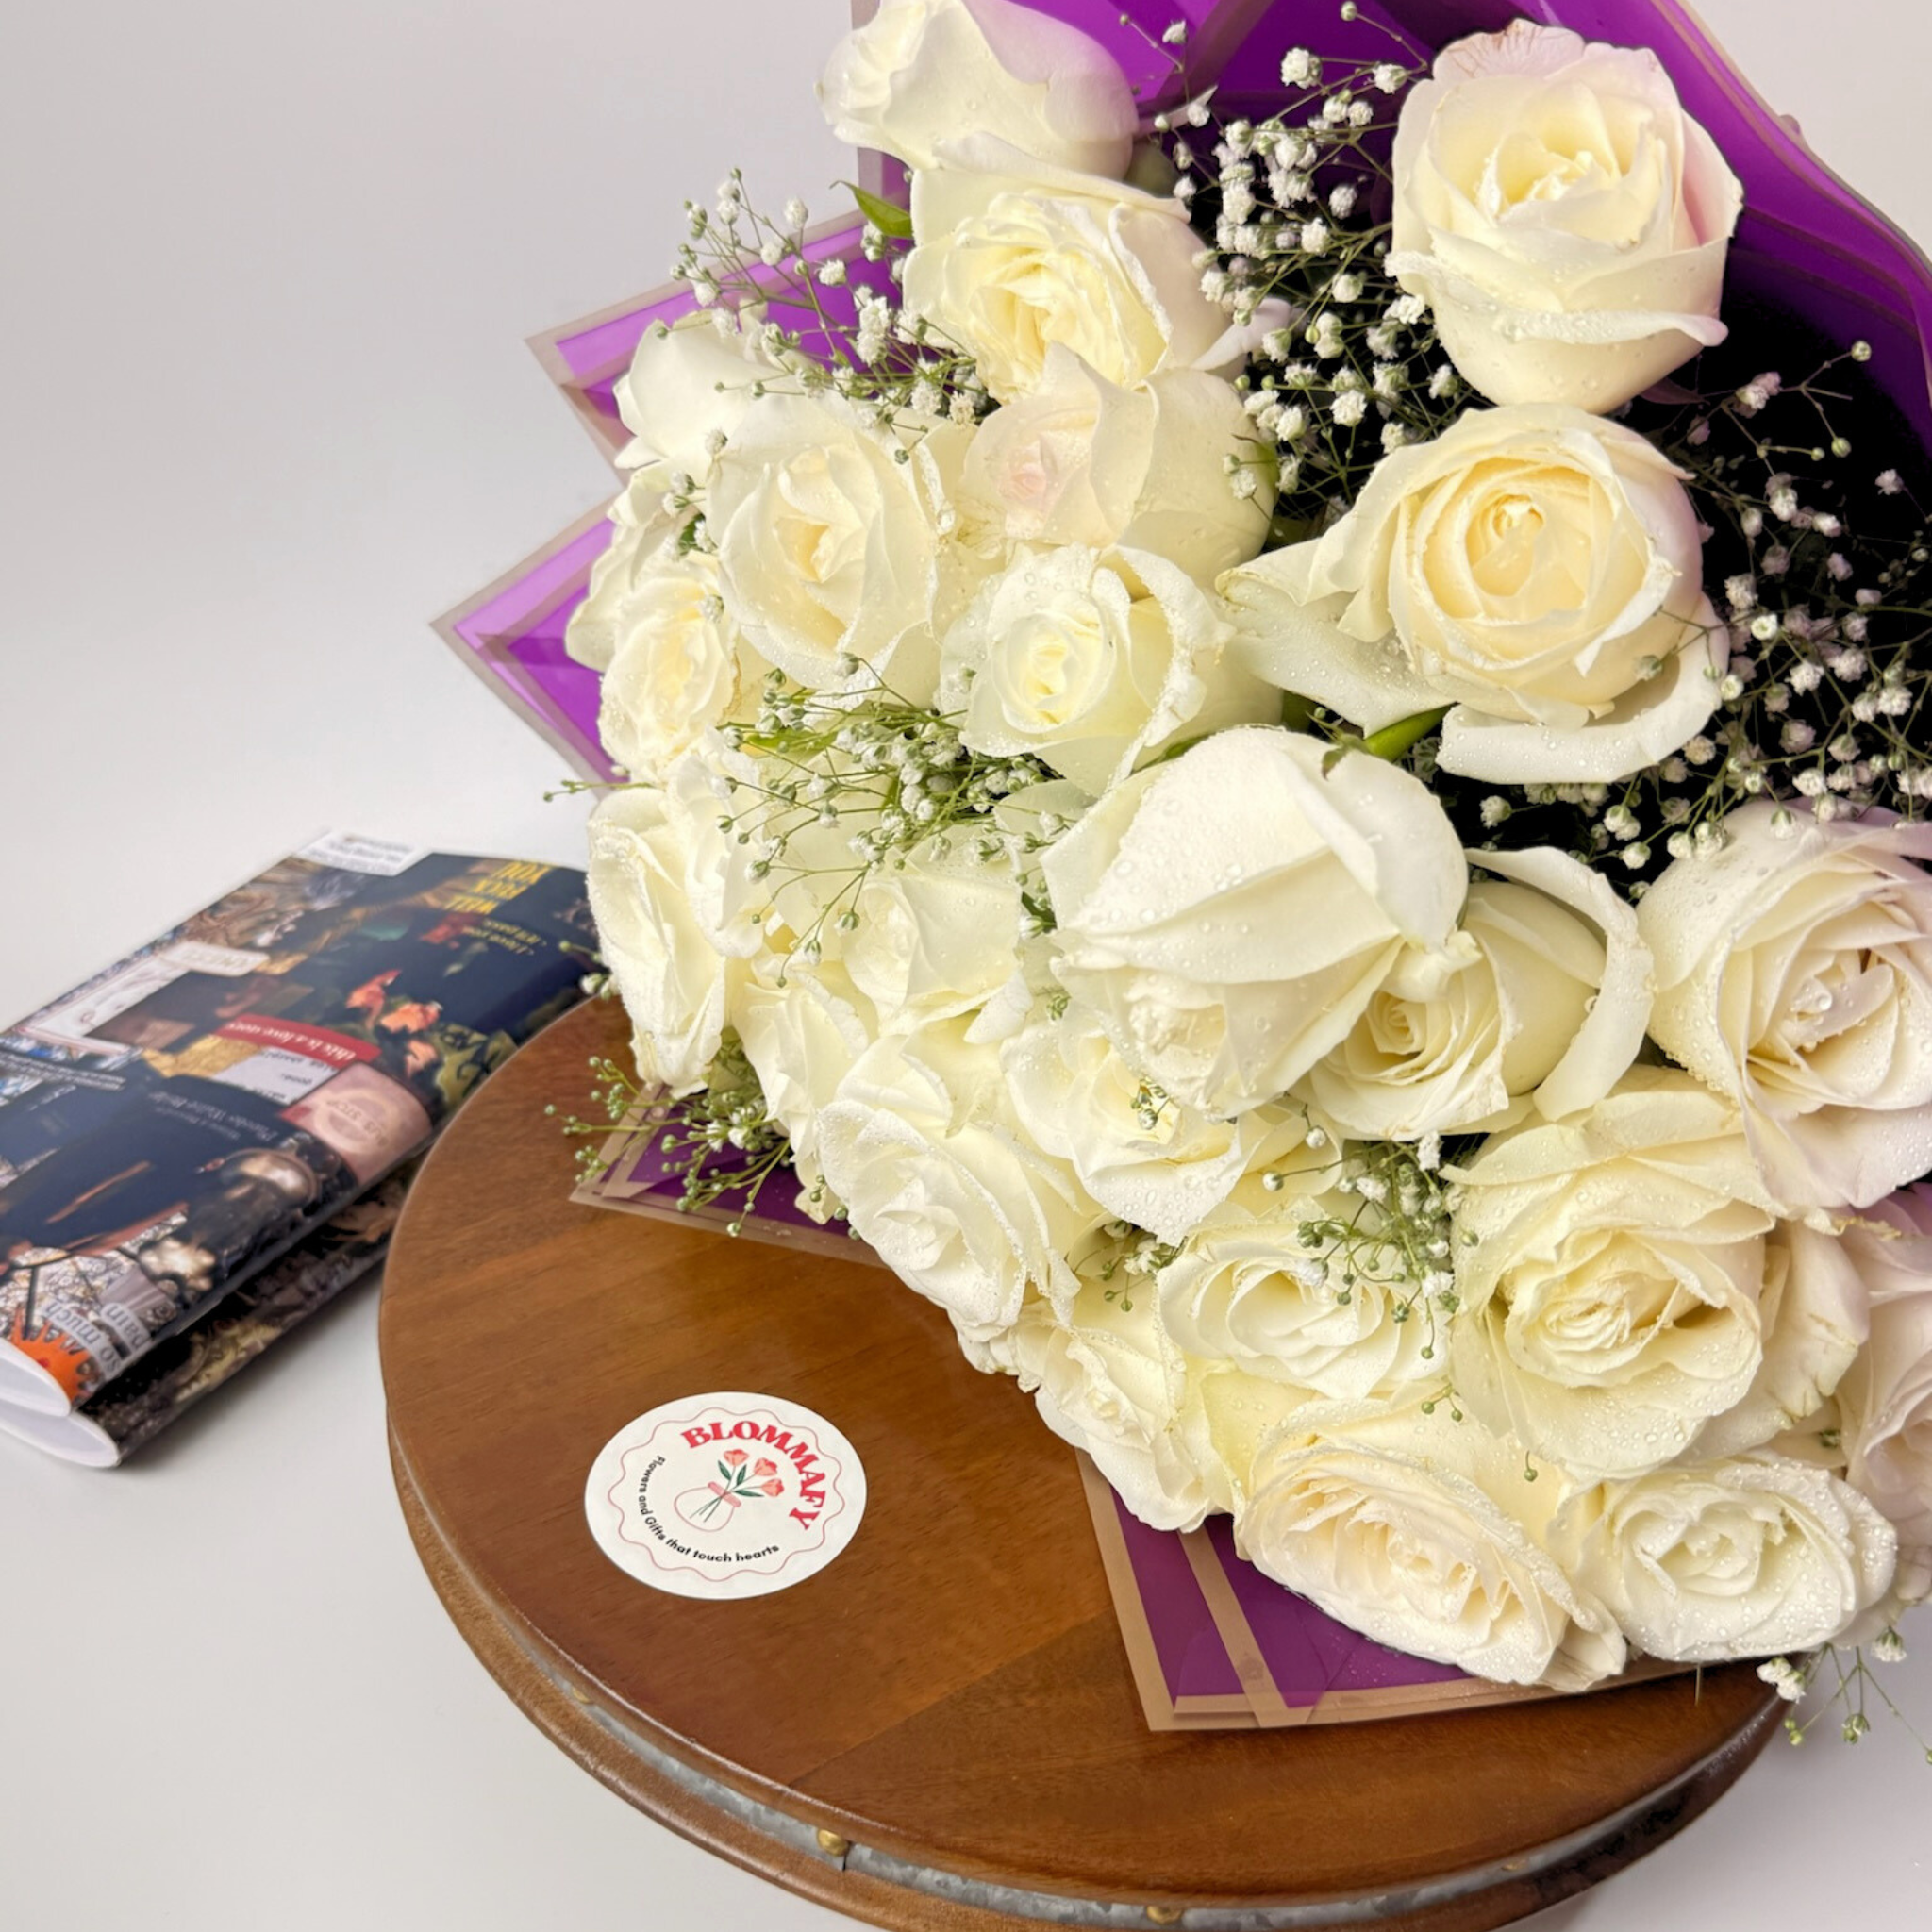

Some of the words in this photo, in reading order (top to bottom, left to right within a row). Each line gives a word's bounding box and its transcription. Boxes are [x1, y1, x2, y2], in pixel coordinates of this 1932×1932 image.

[45, 1301, 101, 1343] much
[106, 1305, 145, 1350] pain
[100, 1347, 121, 1373] so
[639, 1456, 666, 1493] Flowers
[680, 1420, 826, 1530] BLOMMAFY
[638, 1495, 654, 1516] and
[644, 1516, 666, 1541] Gifts
[666, 1538, 691, 1556] that
[693, 1550, 732, 1562] touch
[736, 1544, 780, 1562] hearts
